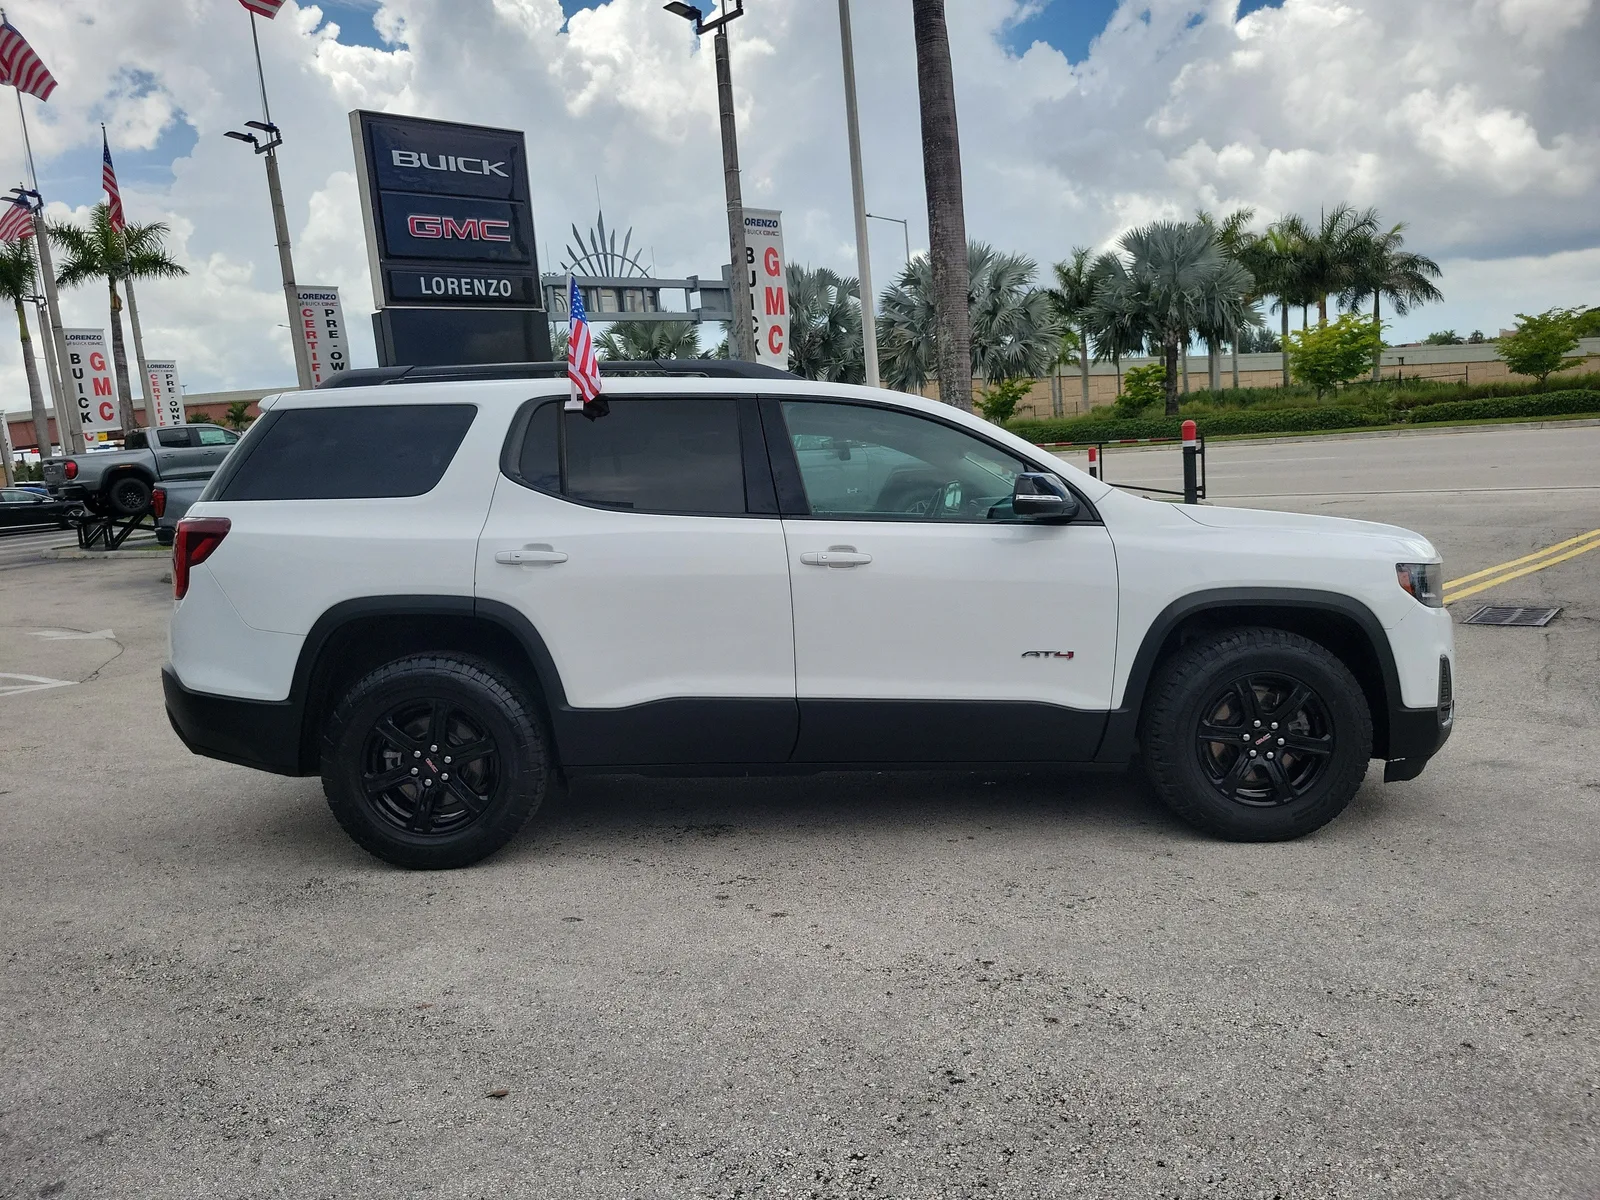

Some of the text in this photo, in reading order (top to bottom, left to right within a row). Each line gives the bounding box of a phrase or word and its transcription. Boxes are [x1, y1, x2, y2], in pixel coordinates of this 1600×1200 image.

[391, 150, 509, 178] BUICK
[407, 215, 511, 242] GMC
[744, 217, 779, 228] ORENZO
[420, 277, 512, 297] LORENZO
[764, 247, 785, 355] GMC
[302, 308, 321, 388] CERTIFI
[324, 309, 345, 375] PRE-OW
[70, 353, 93, 424] BUICK
[89, 352, 115, 422] GMC
[1021, 650, 1075, 660] AT4
[1255, 732, 1272, 746] GMC
